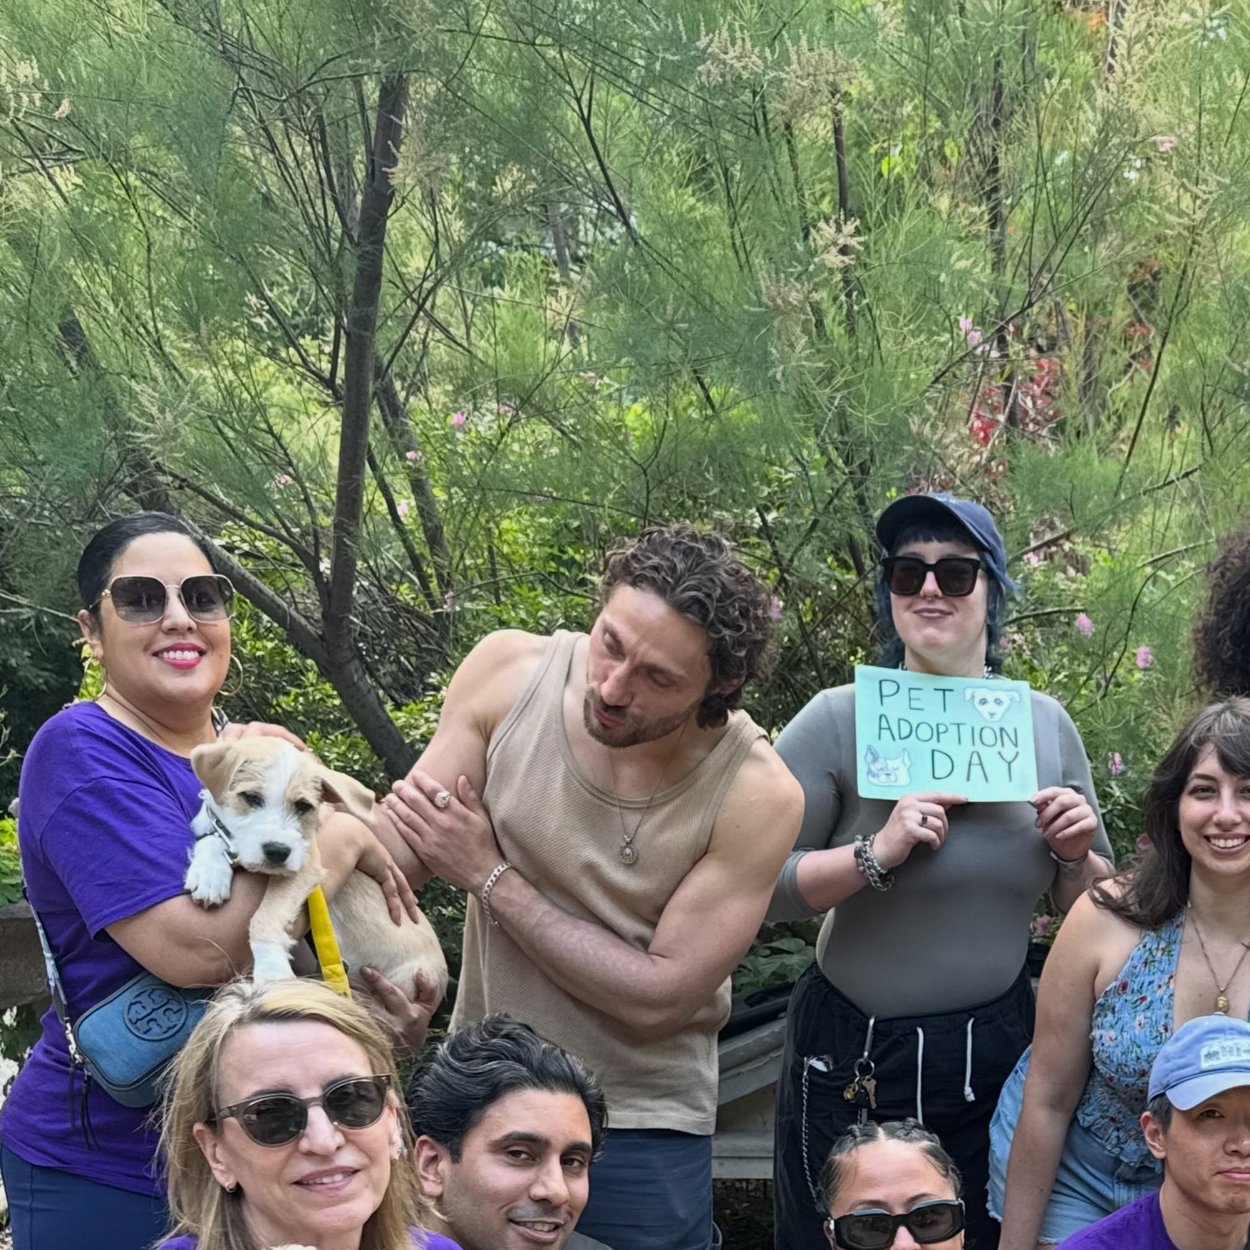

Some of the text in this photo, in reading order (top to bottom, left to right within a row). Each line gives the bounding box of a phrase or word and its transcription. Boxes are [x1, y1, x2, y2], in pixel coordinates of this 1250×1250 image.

[879, 679, 954, 712] PET
[878, 713, 1018, 748] ADOPTION
[931, 749, 1019, 783] DAY
